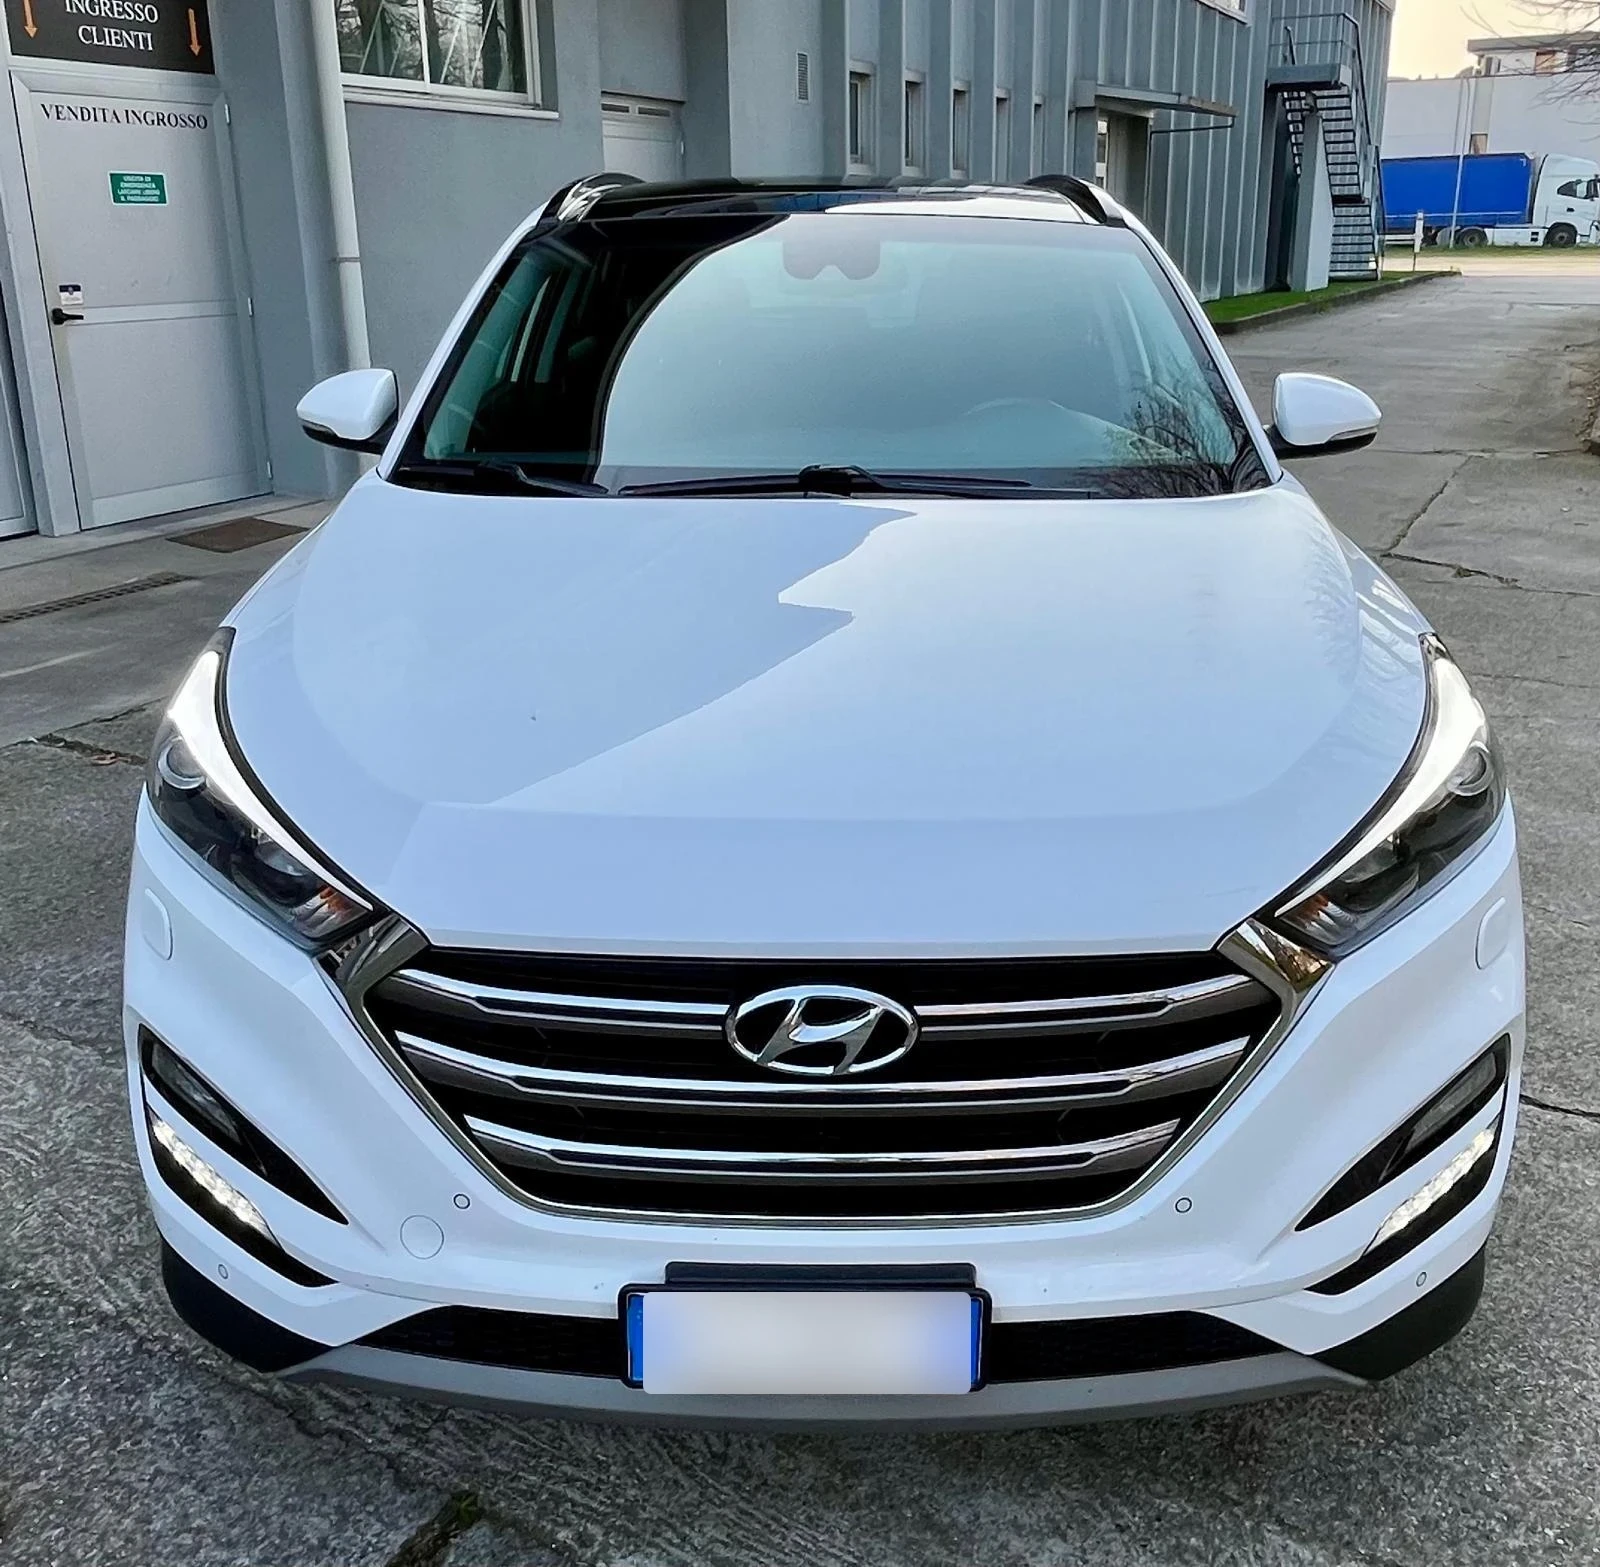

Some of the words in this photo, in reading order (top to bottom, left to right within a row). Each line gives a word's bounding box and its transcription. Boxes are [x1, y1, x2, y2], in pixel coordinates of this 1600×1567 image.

[66, 0, 159, 23] INGRESSO
[78, 25, 153, 51] CLIENTI
[41, 103, 121, 123] VENDITA
[124, 109, 208, 130] INGROSSO
